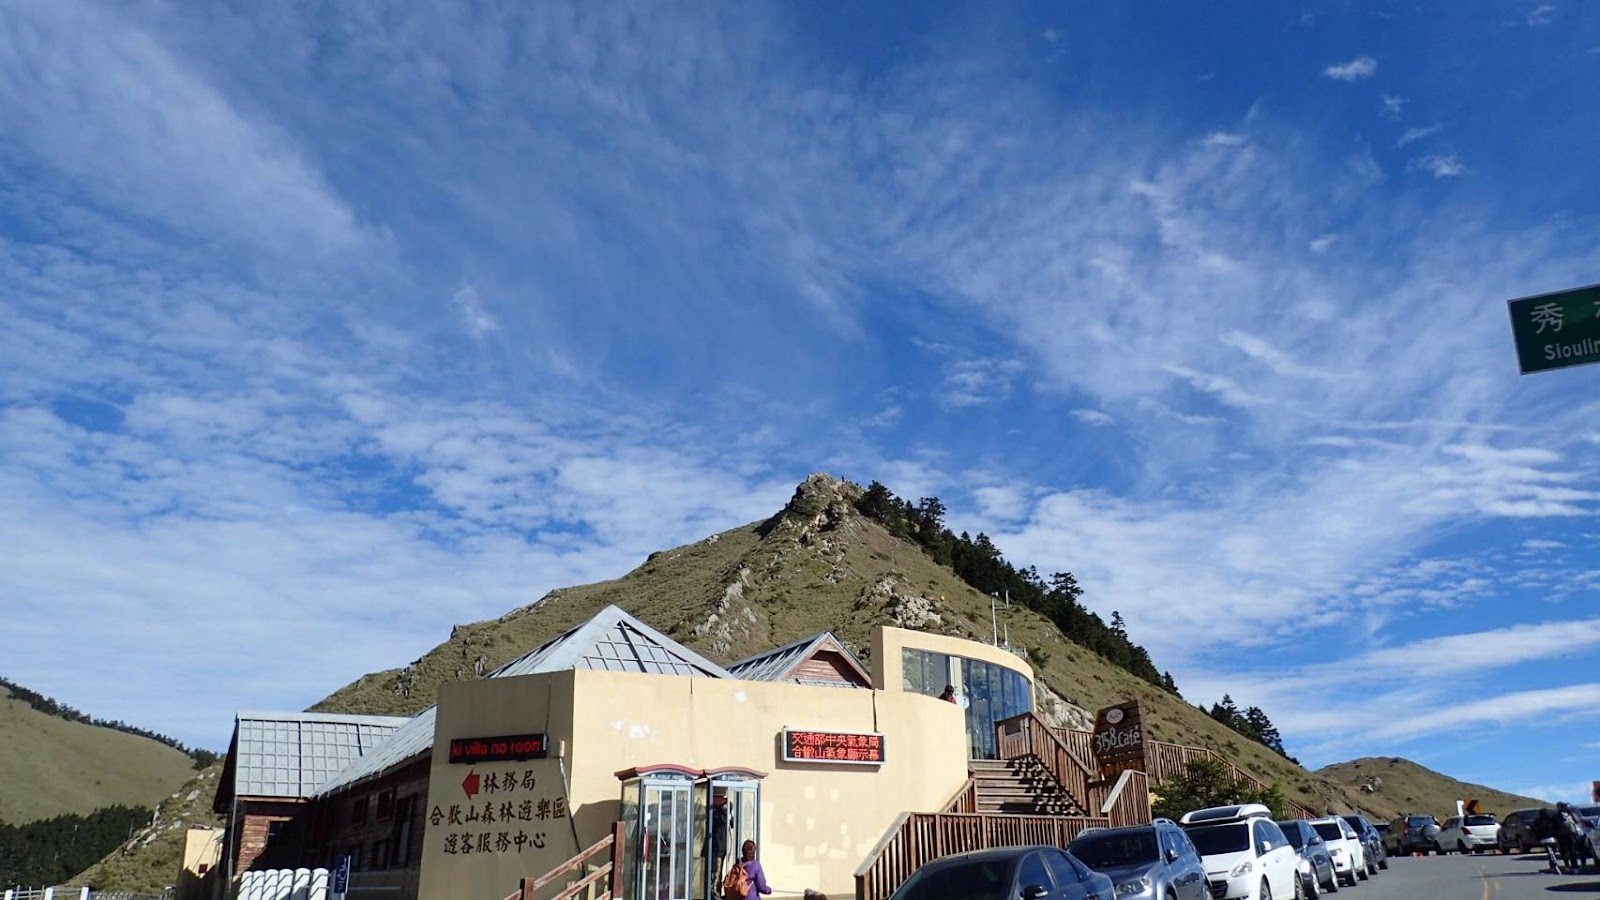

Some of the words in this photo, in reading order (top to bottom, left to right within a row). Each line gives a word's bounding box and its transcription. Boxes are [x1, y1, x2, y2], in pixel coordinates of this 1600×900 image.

[1530, 300, 1600, 334] 秀
[465, 741, 488, 755] villa
[491, 741, 508, 754] no
[1095, 727, 1117, 754] 3158
[483, 770, 536, 794] 林務局
[429, 796, 566, 826] 合歡山森林遊樂區
[443, 829, 547, 854] 遊客服務中心
